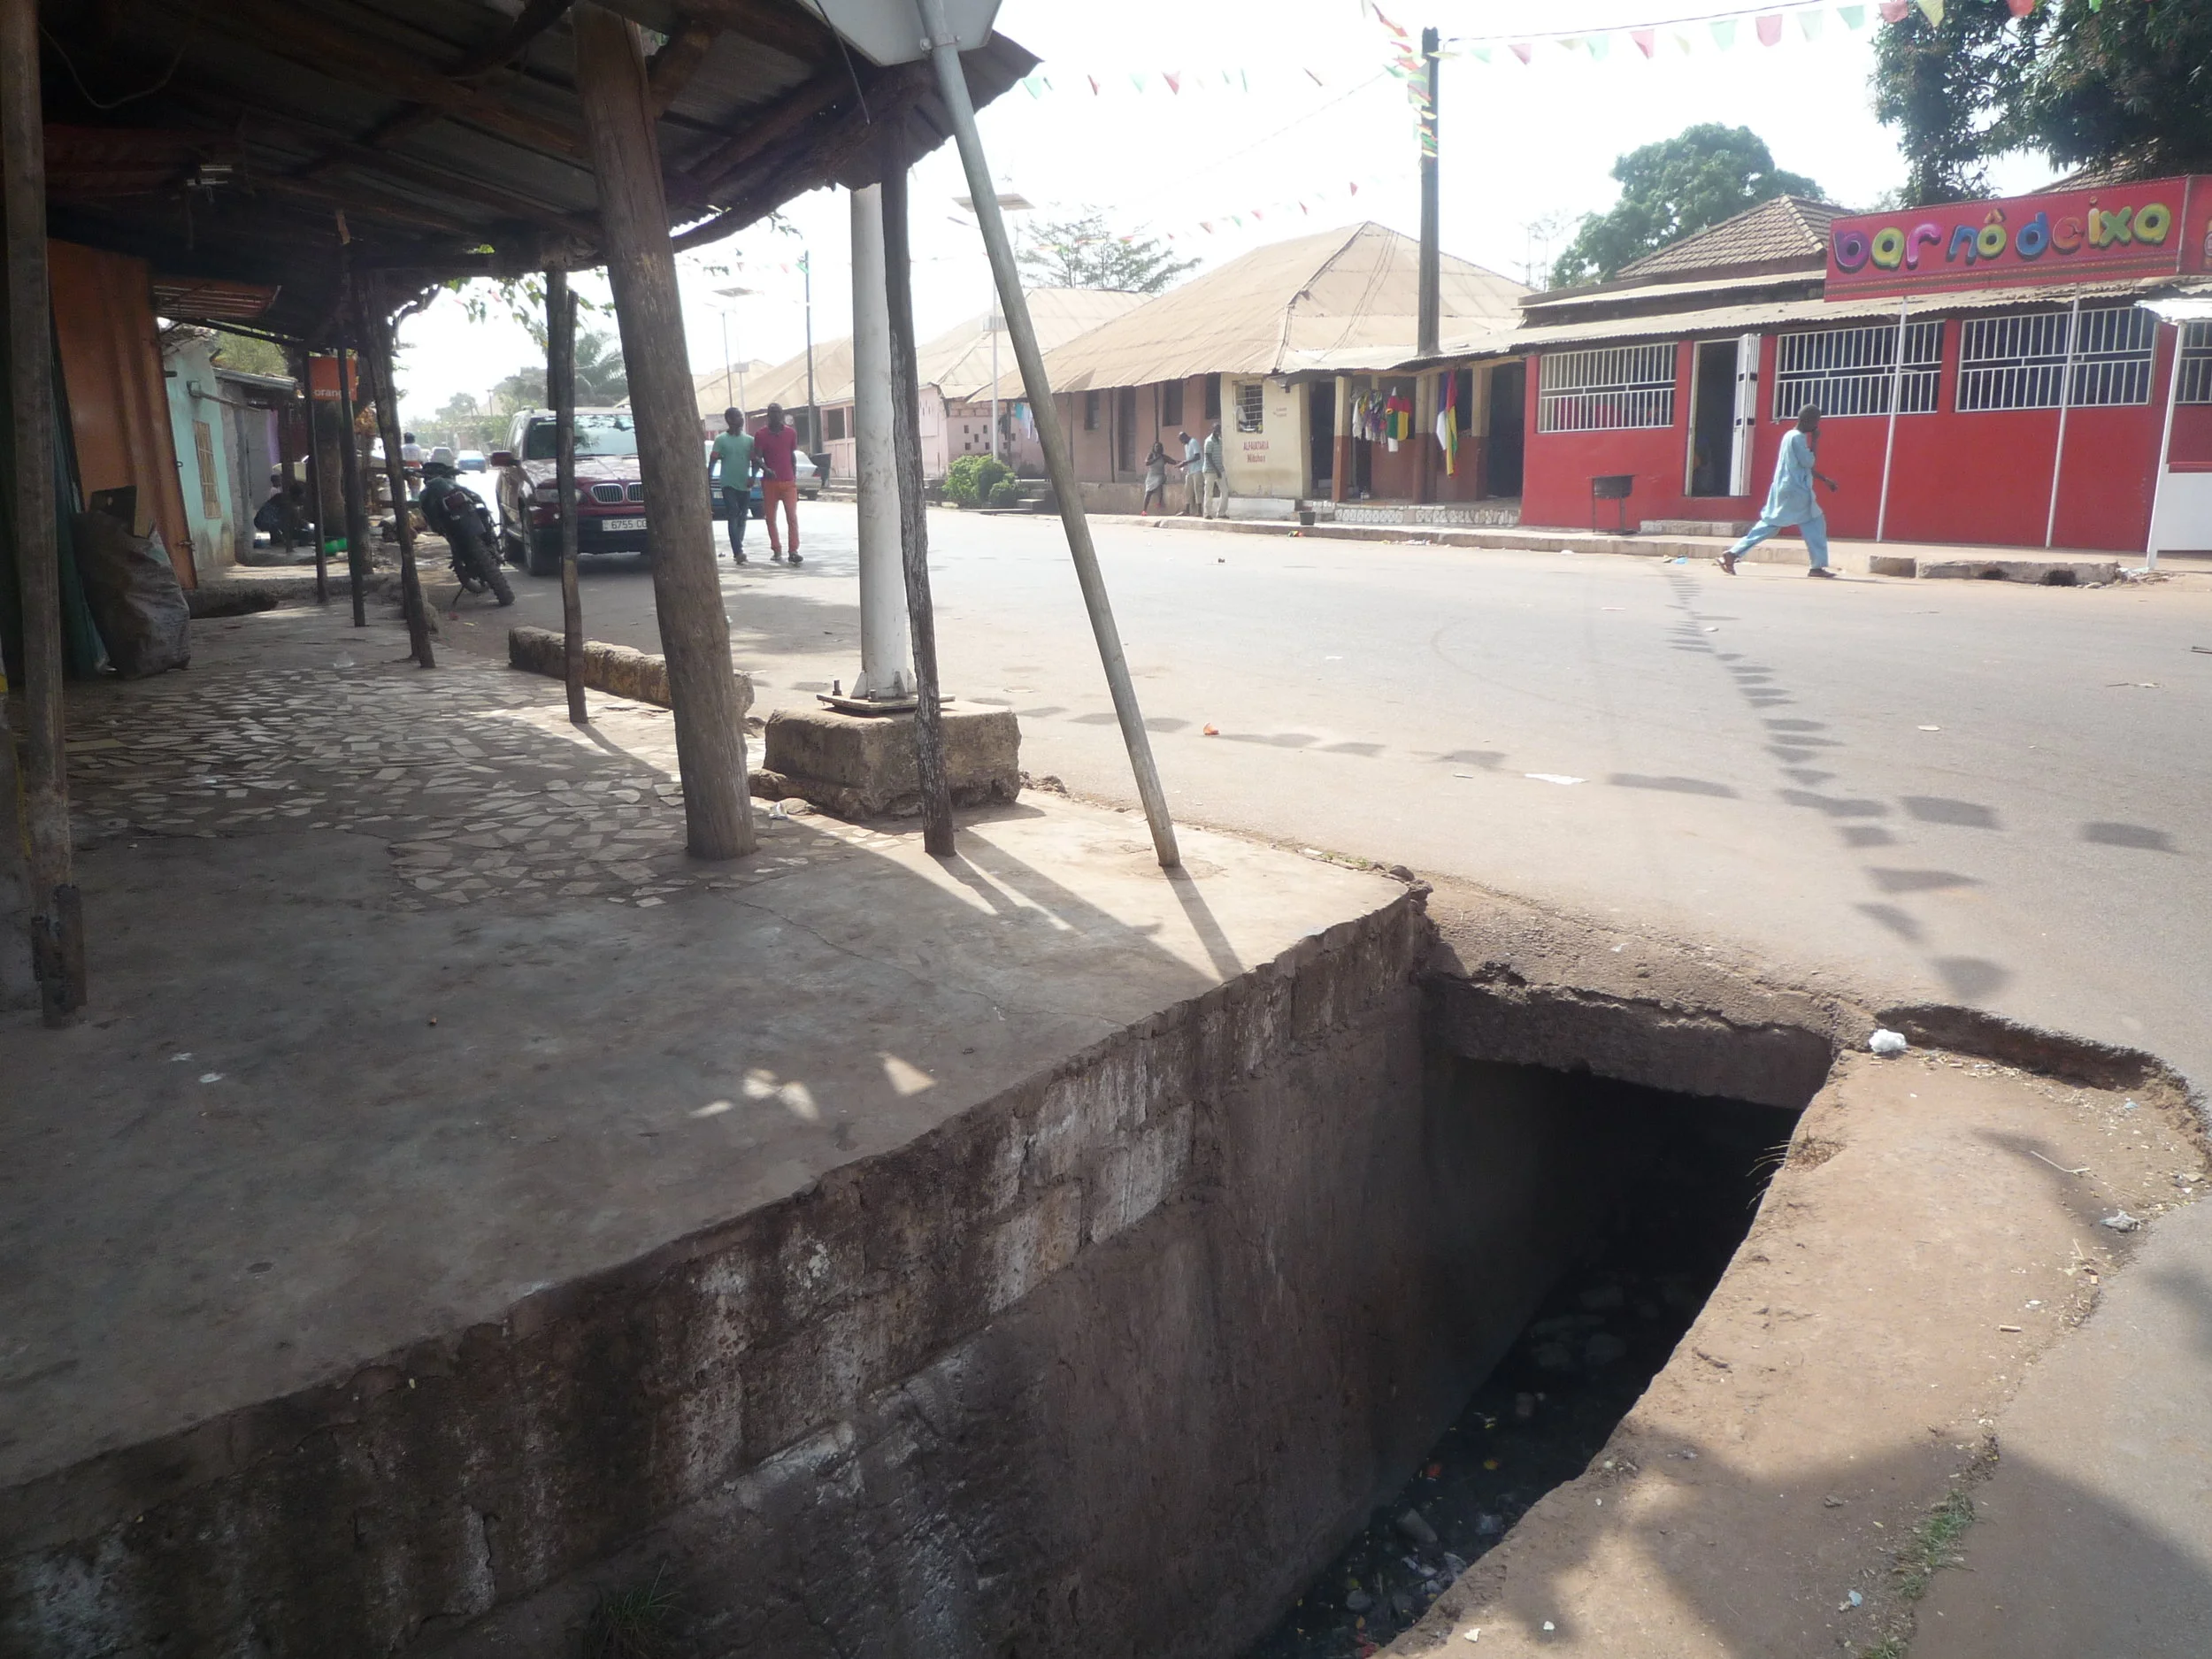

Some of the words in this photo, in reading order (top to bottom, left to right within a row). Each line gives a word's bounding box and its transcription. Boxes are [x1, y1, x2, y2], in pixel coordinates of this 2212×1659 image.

[1833, 223, 1941, 271] bar
[2016, 196, 2170, 258] deixa
[611, 520, 634, 529] 6755
